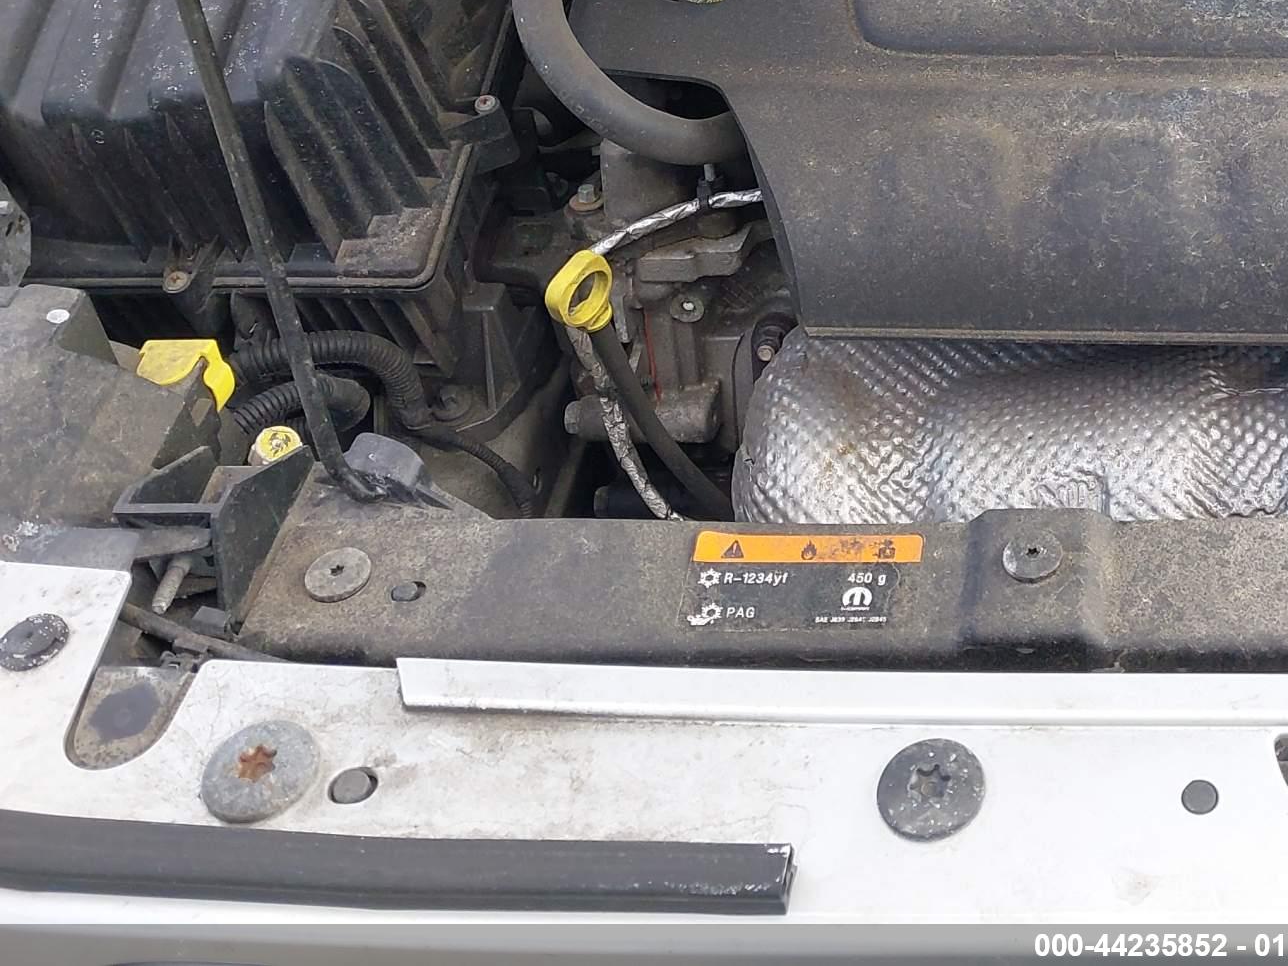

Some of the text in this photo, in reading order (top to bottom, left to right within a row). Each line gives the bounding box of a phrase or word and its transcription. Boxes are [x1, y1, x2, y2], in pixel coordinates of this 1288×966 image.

[722, 570, 888, 587] R-1234yf 450 g
[725, 606, 756, 619] PAG
